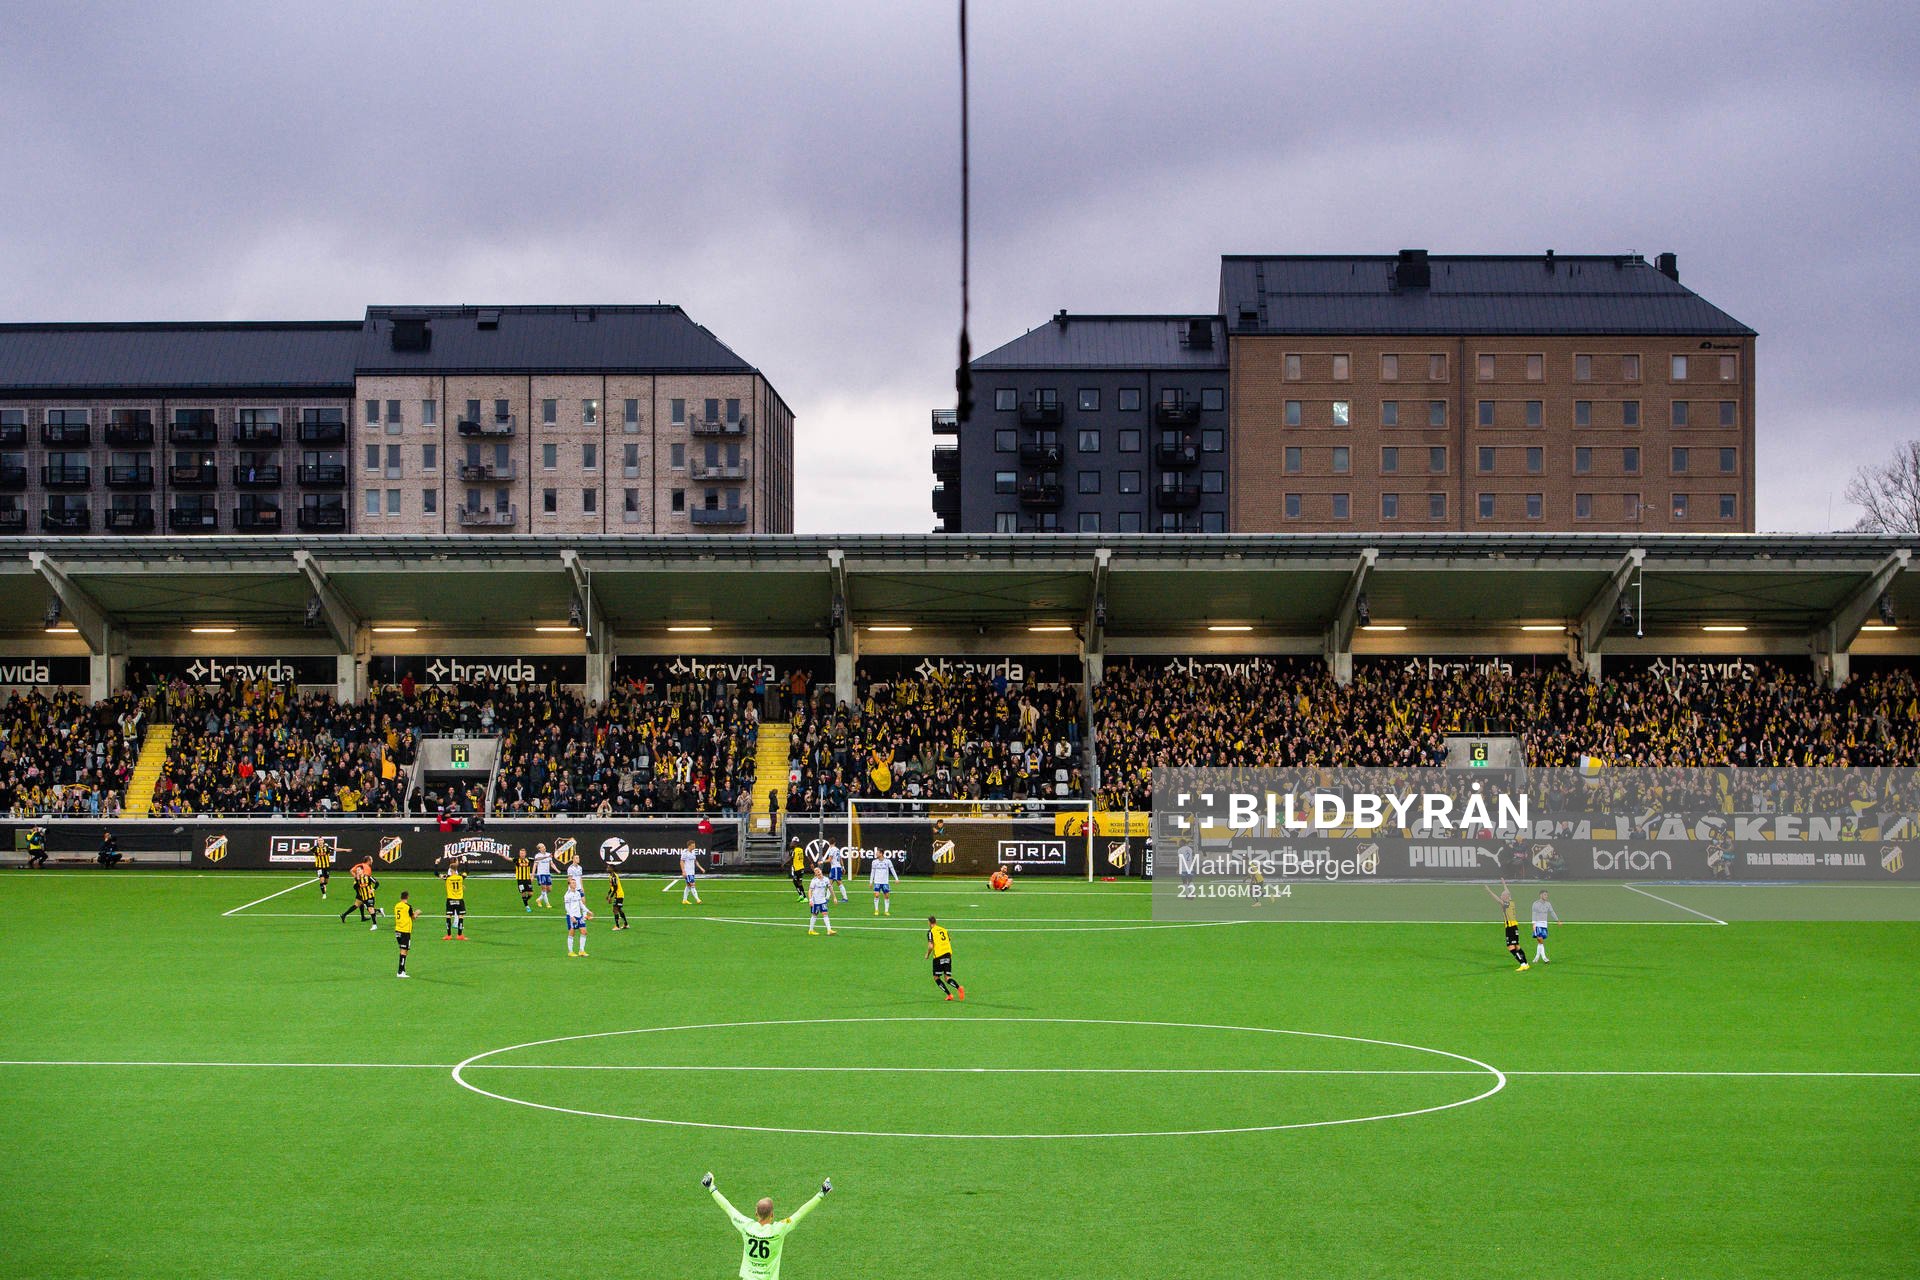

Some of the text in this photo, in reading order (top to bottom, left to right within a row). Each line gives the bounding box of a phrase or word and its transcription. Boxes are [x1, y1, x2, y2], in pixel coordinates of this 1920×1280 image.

[0, 660, 49, 682] vida
[452, 658, 535, 682] bravida
[455, 749, 465, 761] H
[1475, 748, 1485, 760] G
[443, 840, 511, 859] KOPPARBERG
[632, 848, 706, 856] KRANPUNKEN
[1409, 846, 1477, 867] PUMA
[1592, 846, 1672, 871] brion
[452, 881, 459, 890] 11
[396, 910, 401, 919] 5
[939, 931, 946, 940] 3
[748, 1238, 769, 1258] 26
